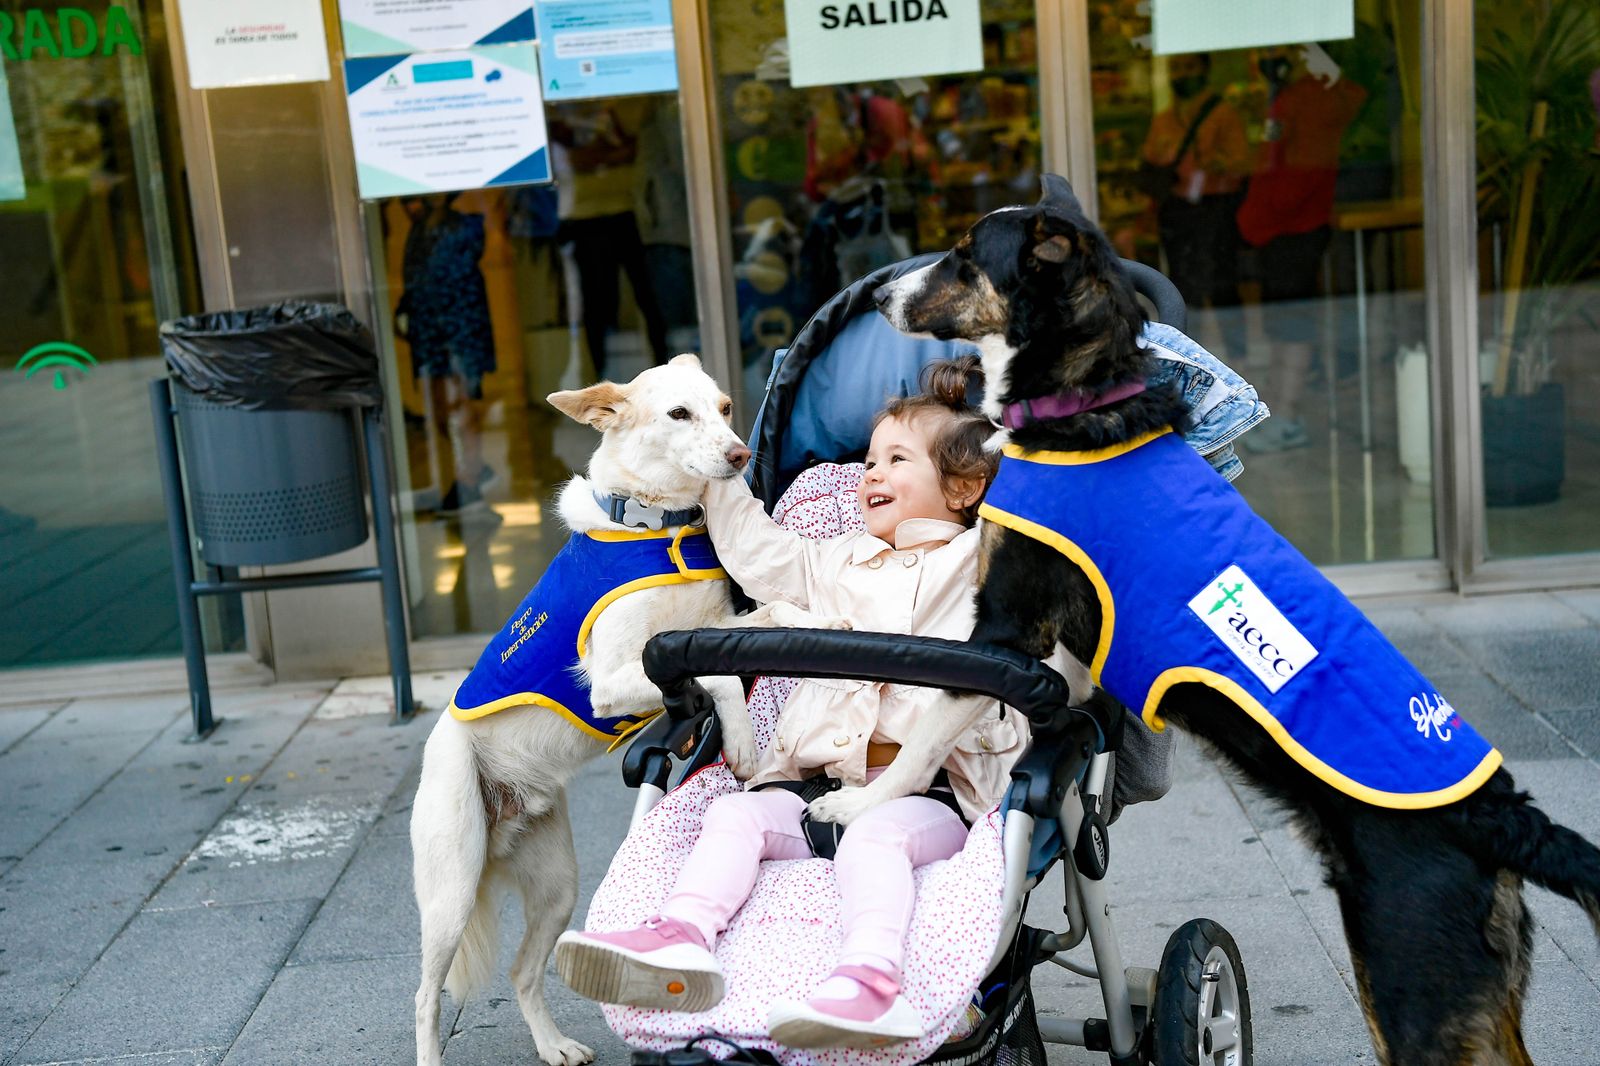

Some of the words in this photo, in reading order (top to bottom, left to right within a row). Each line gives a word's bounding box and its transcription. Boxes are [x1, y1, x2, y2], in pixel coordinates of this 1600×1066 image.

[820, 0, 948, 29] SALIDA
[501, 611, 548, 664] Intervención
[510, 606, 533, 636] Perro
[1228, 611, 1294, 678] aecc
